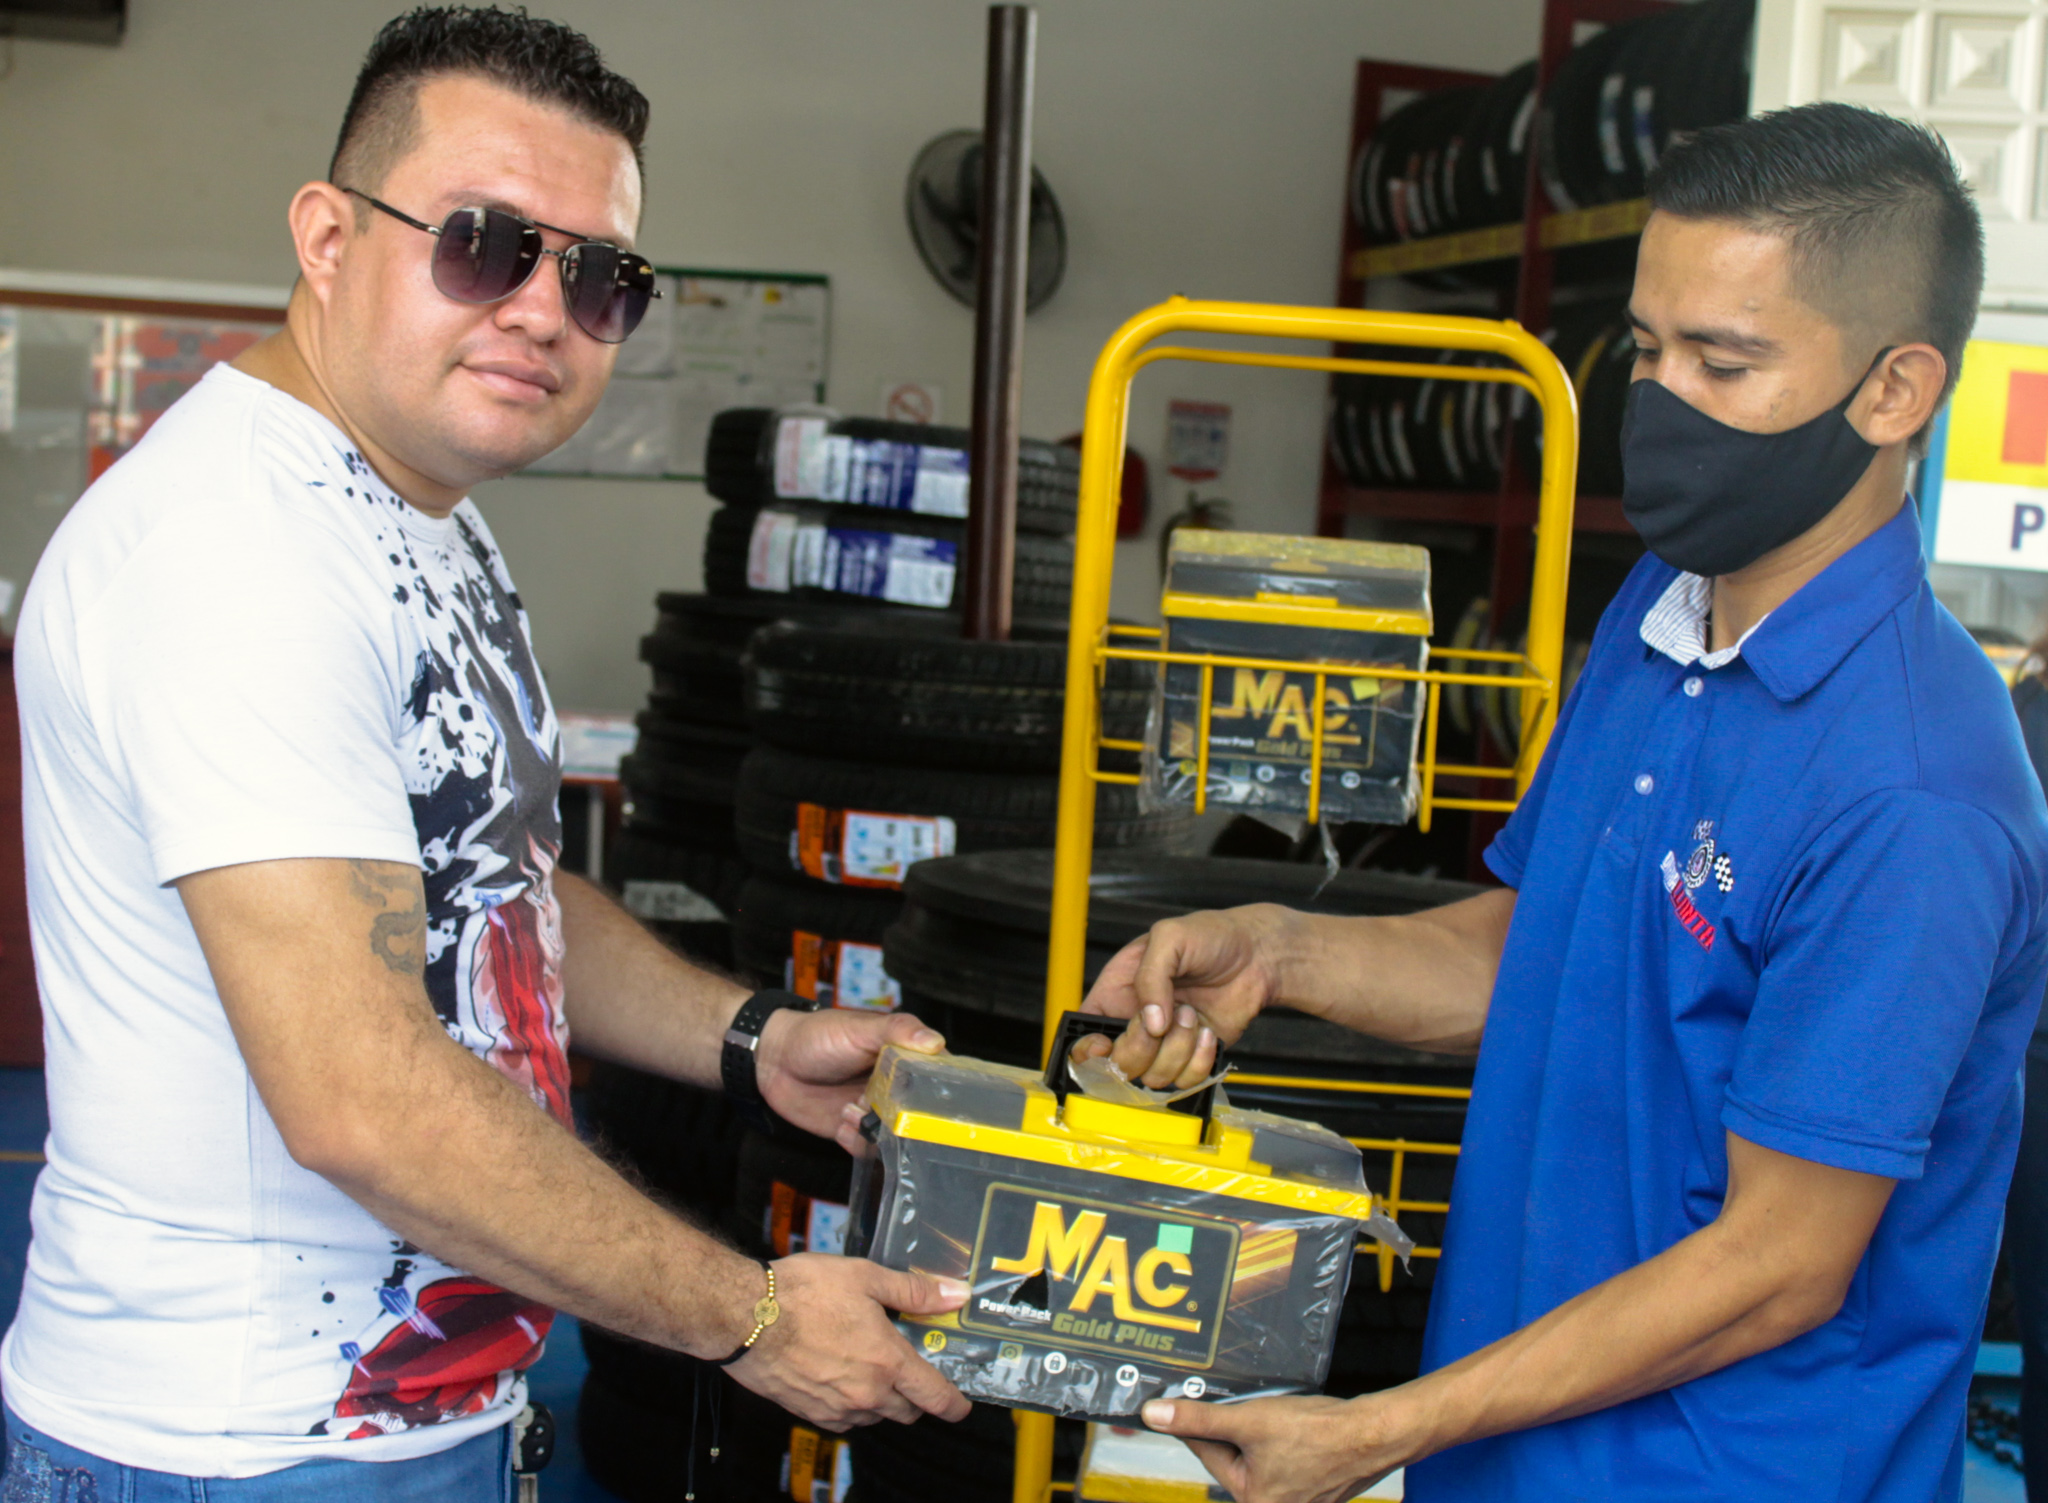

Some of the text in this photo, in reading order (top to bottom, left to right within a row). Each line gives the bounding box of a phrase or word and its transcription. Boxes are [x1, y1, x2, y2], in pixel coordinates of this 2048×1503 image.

[1210, 667, 1361, 745] MAC
[991, 1201, 1202, 1333] MAC
[929, 1333, 943, 1345] 18
[1052, 1313, 1113, 1341] Gold
[1115, 1322, 1176, 1351] Plus
